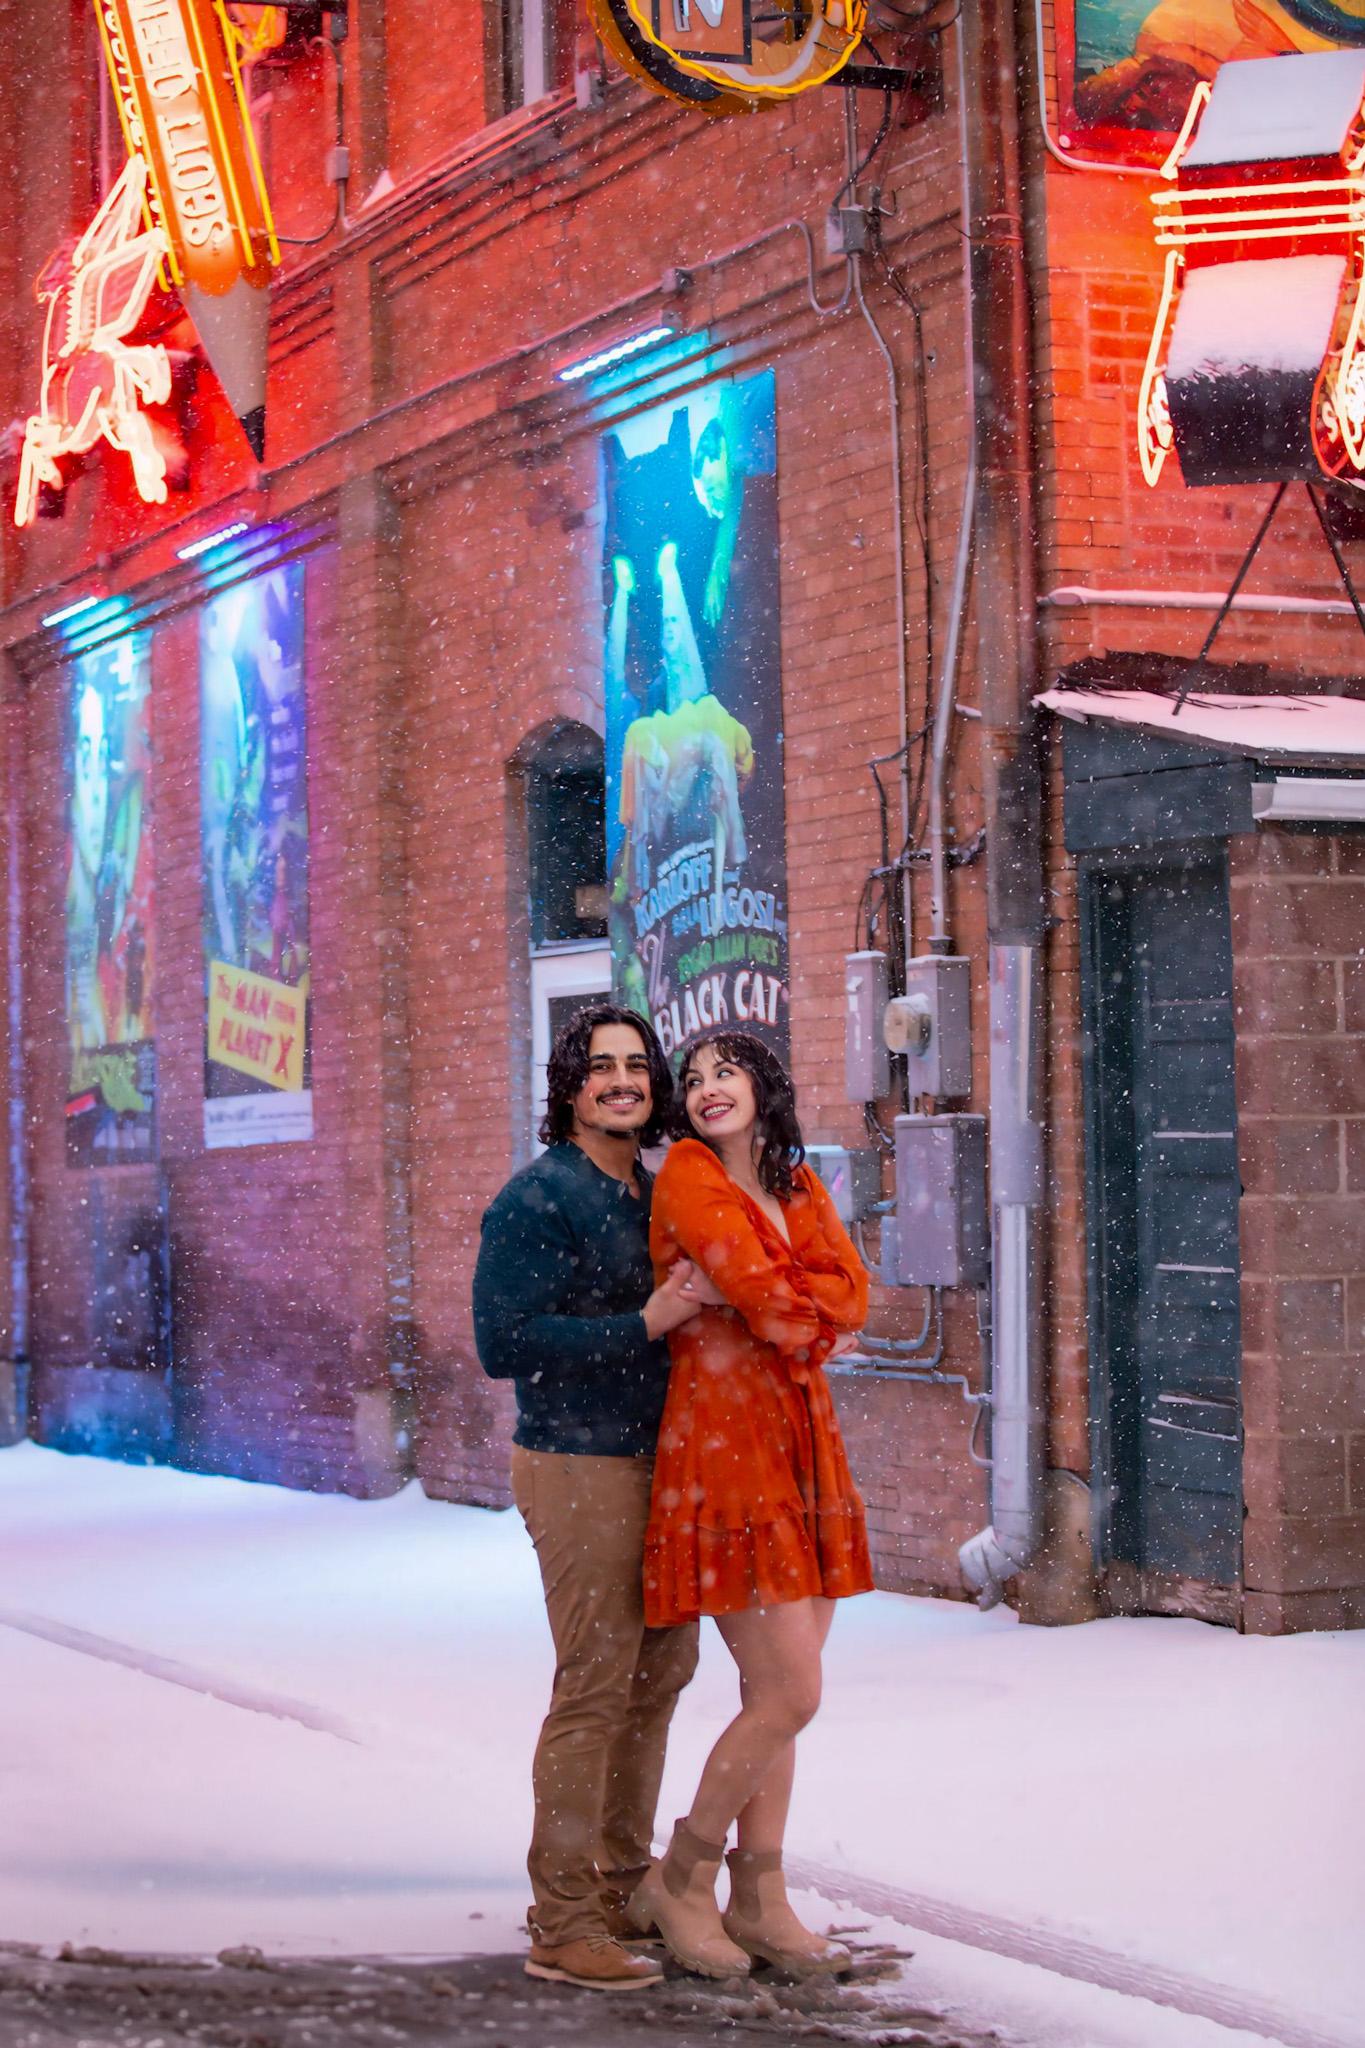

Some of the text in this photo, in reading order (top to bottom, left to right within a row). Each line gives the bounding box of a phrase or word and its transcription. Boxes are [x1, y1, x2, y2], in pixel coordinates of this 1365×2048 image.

[654, 970, 782, 1057] BLACK CAT
[273, 1031, 294, 1080] X
